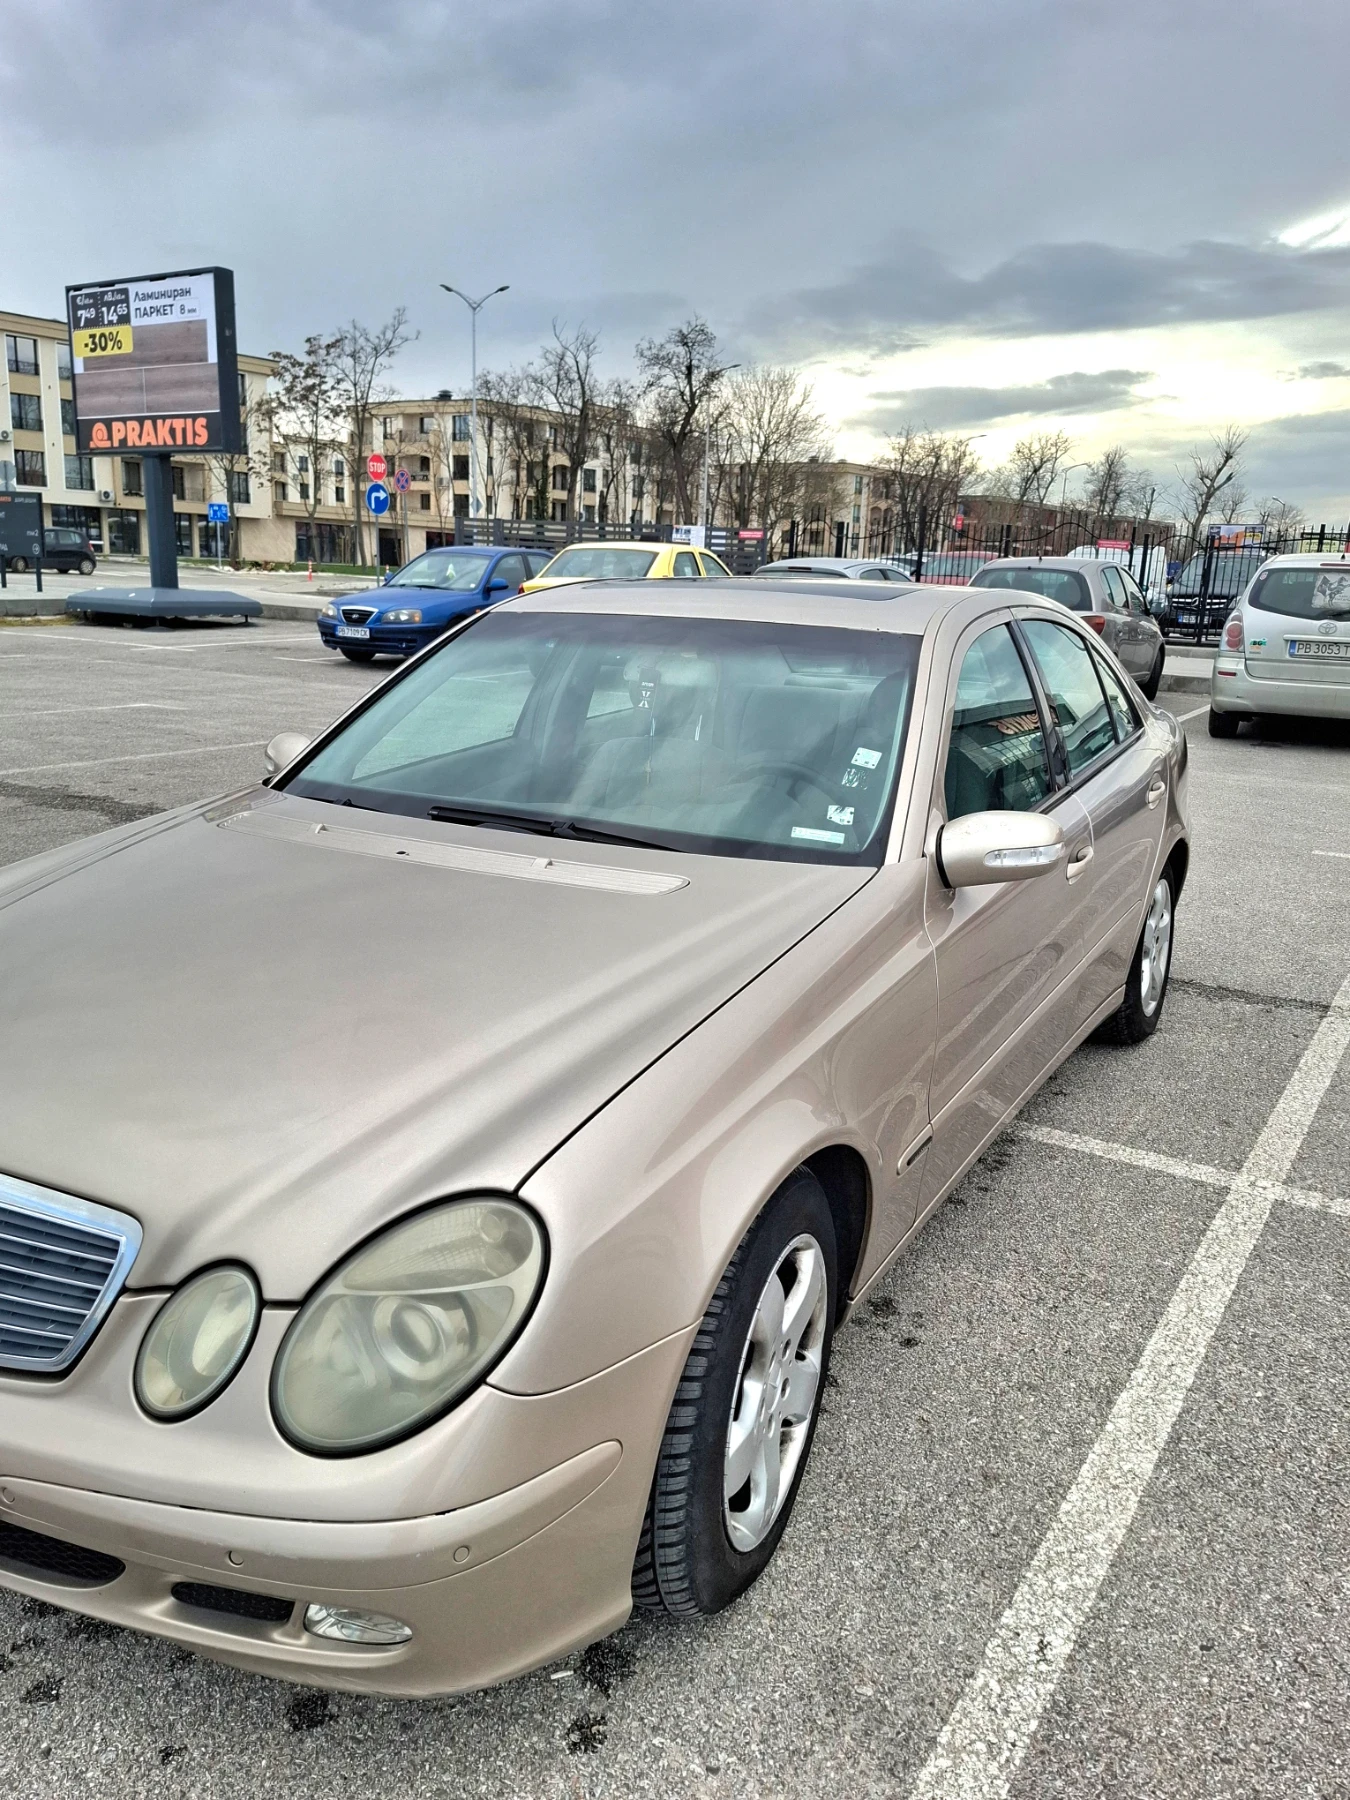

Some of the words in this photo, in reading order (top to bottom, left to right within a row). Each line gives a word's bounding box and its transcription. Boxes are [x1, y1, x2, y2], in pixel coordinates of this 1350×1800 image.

[134, 287, 191, 302] Ламиниран
[135, 304, 175, 318] ПАРКЕТ
[180, 304, 186, 315] 8
[84, 331, 123, 352] -30%
[111, 417, 209, 447] PRAKTIS
[368, 461, 386, 474] STOP
[1297, 643, 1311, 653] PB
[1313, 643, 1341, 655] 3053
